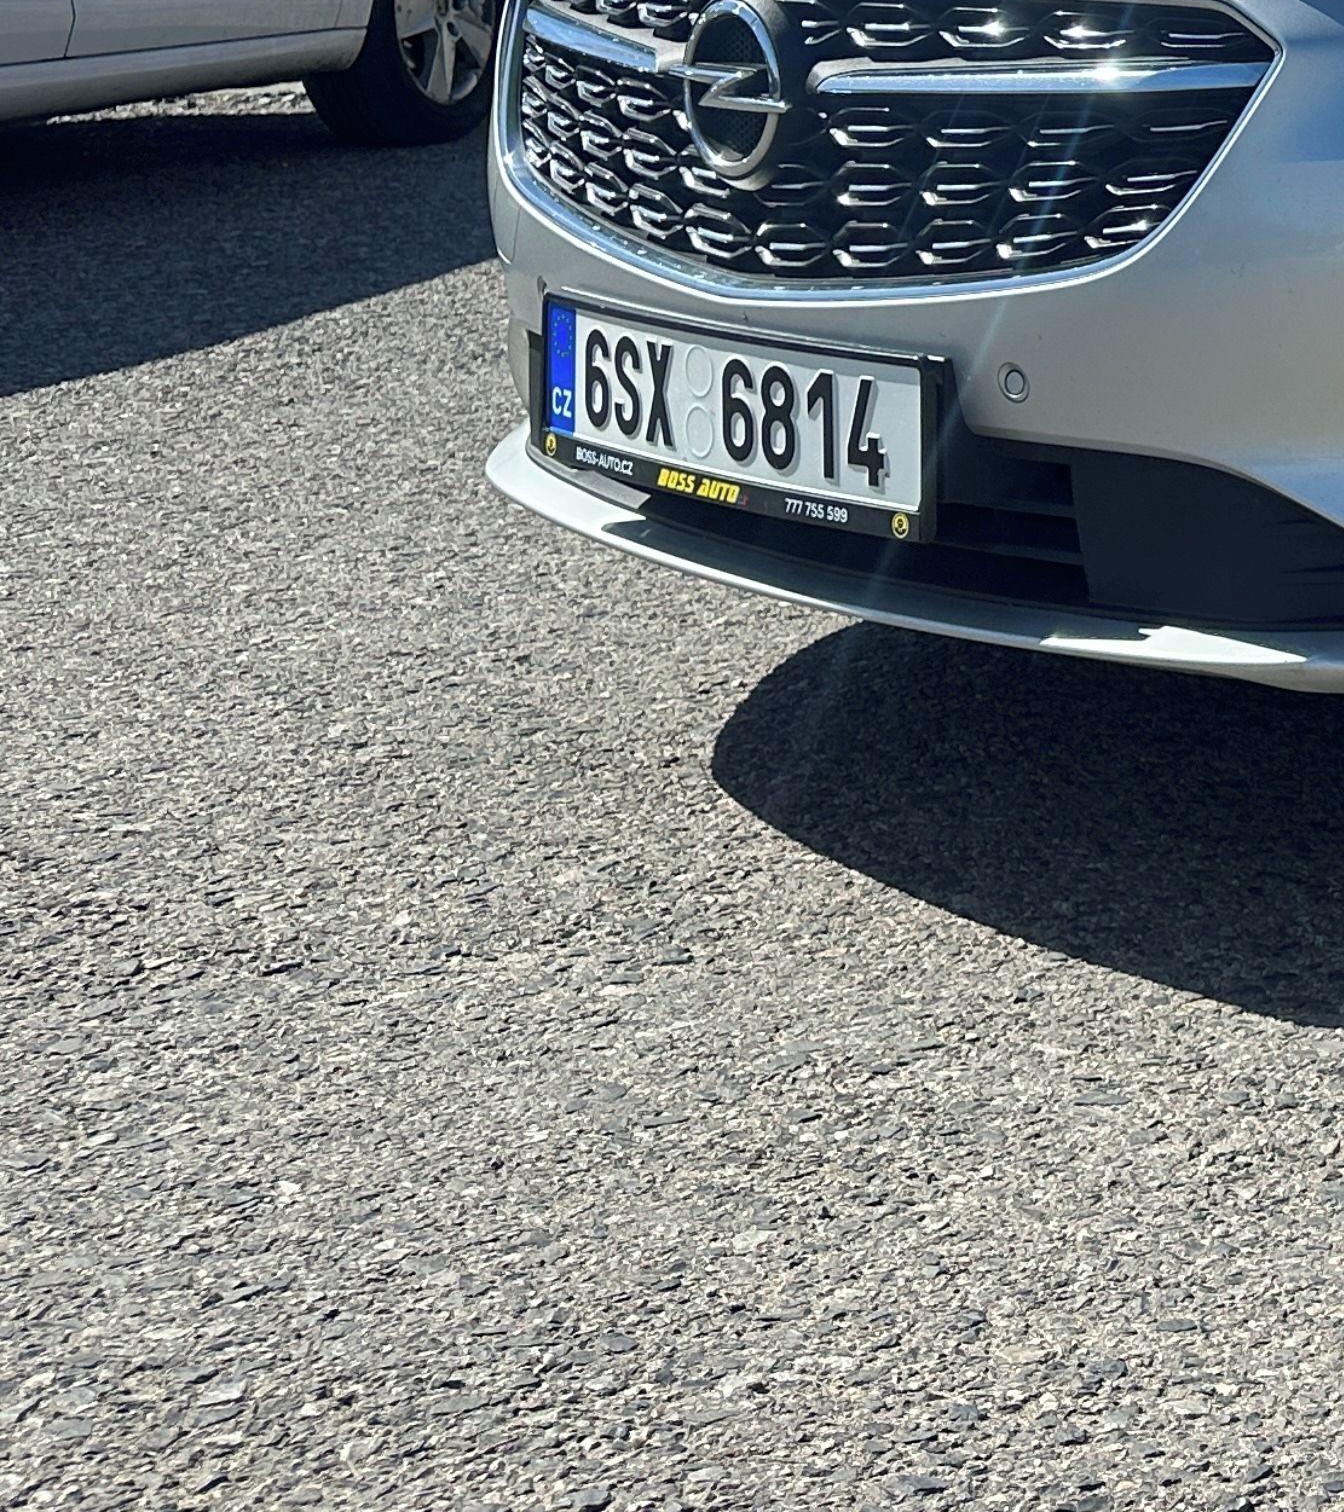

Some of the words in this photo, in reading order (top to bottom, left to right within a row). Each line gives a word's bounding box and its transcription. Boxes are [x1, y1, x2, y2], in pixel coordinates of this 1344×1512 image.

[552, 387, 572, 419] CZ
[585, 329, 673, 448] 6SX
[721, 358, 885, 487] 6814
[576, 447, 633, 476] BOSS-AUTO.CZ
[657, 468, 696, 494] BOSS
[696, 478, 740, 503] AUTO
[785, 498, 804, 514] 777
[805, 502, 825, 519] 755
[827, 506, 848, 523] 599
